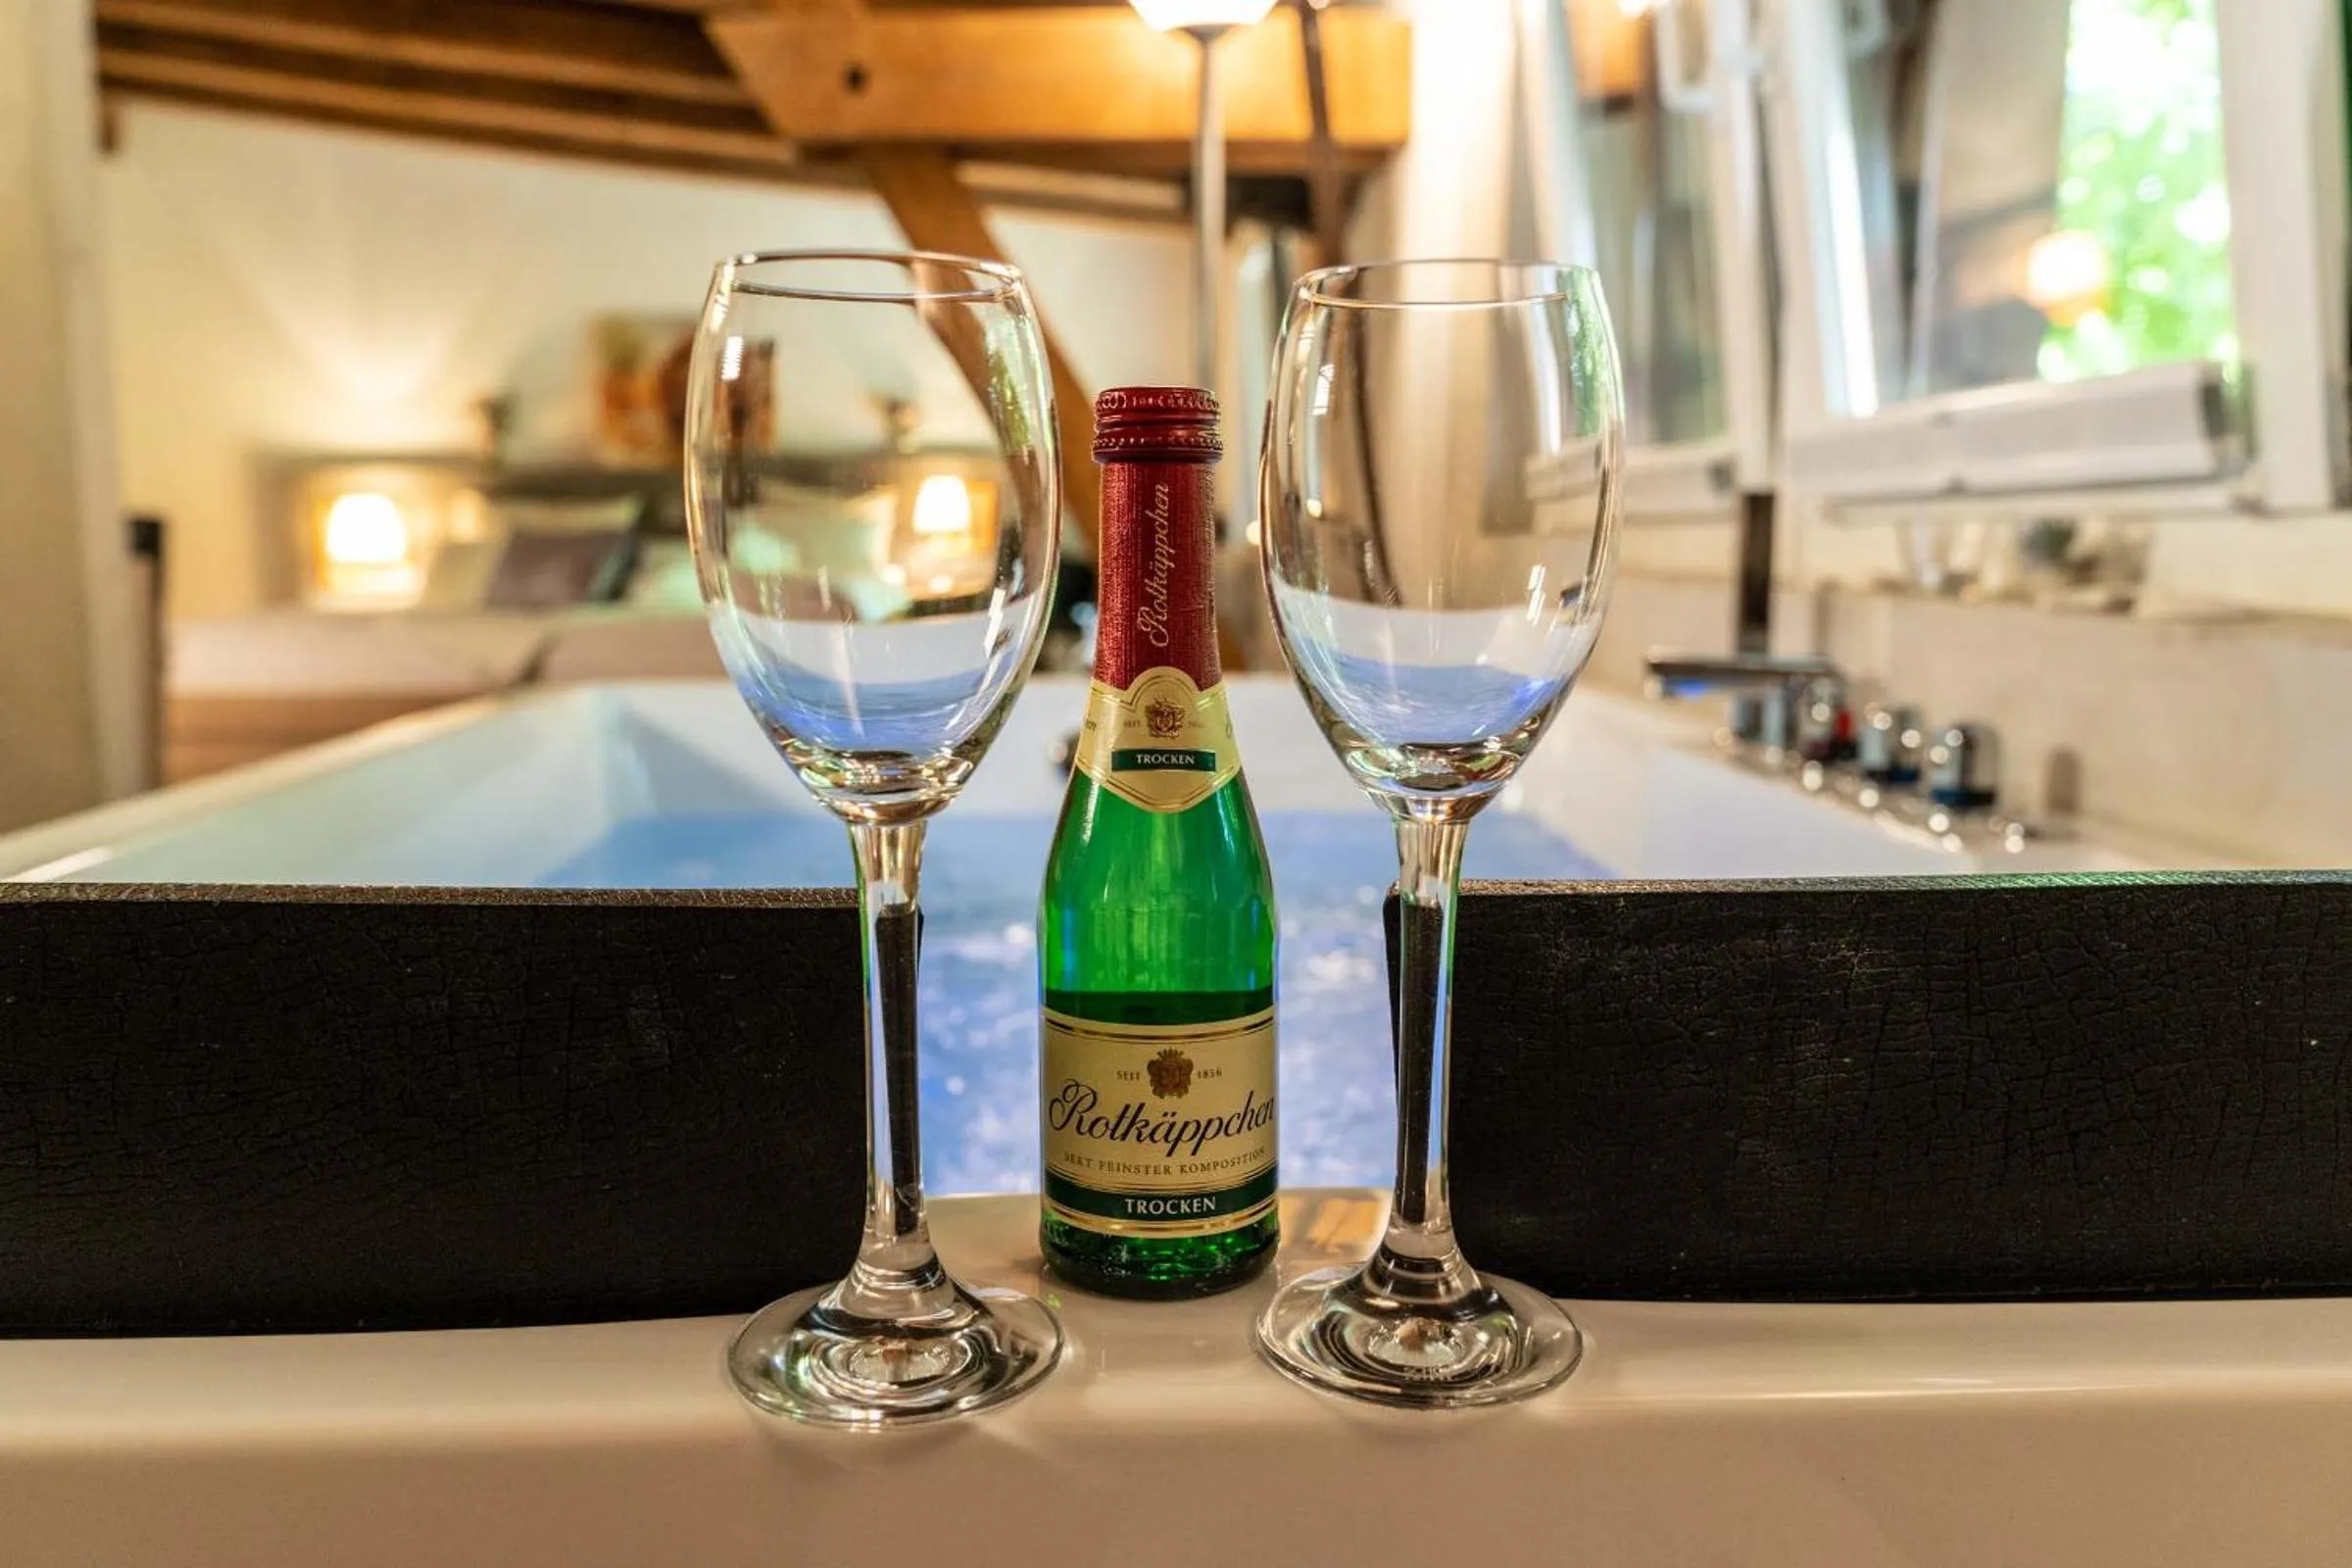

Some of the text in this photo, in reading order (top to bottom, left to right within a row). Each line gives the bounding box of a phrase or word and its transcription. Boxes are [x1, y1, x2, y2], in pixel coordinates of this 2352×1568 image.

[1138, 483, 1175, 647] Rotkäppchen
[1135, 753, 1196, 764] TROCKEN
[1049, 1078, 1275, 1157] Rotkäppchen
[1099, 1160, 1172, 1176] FEINSTER
[1179, 1146, 1265, 1175] KOMPOSITION
[1125, 1197, 1216, 1215] TROCKEN
